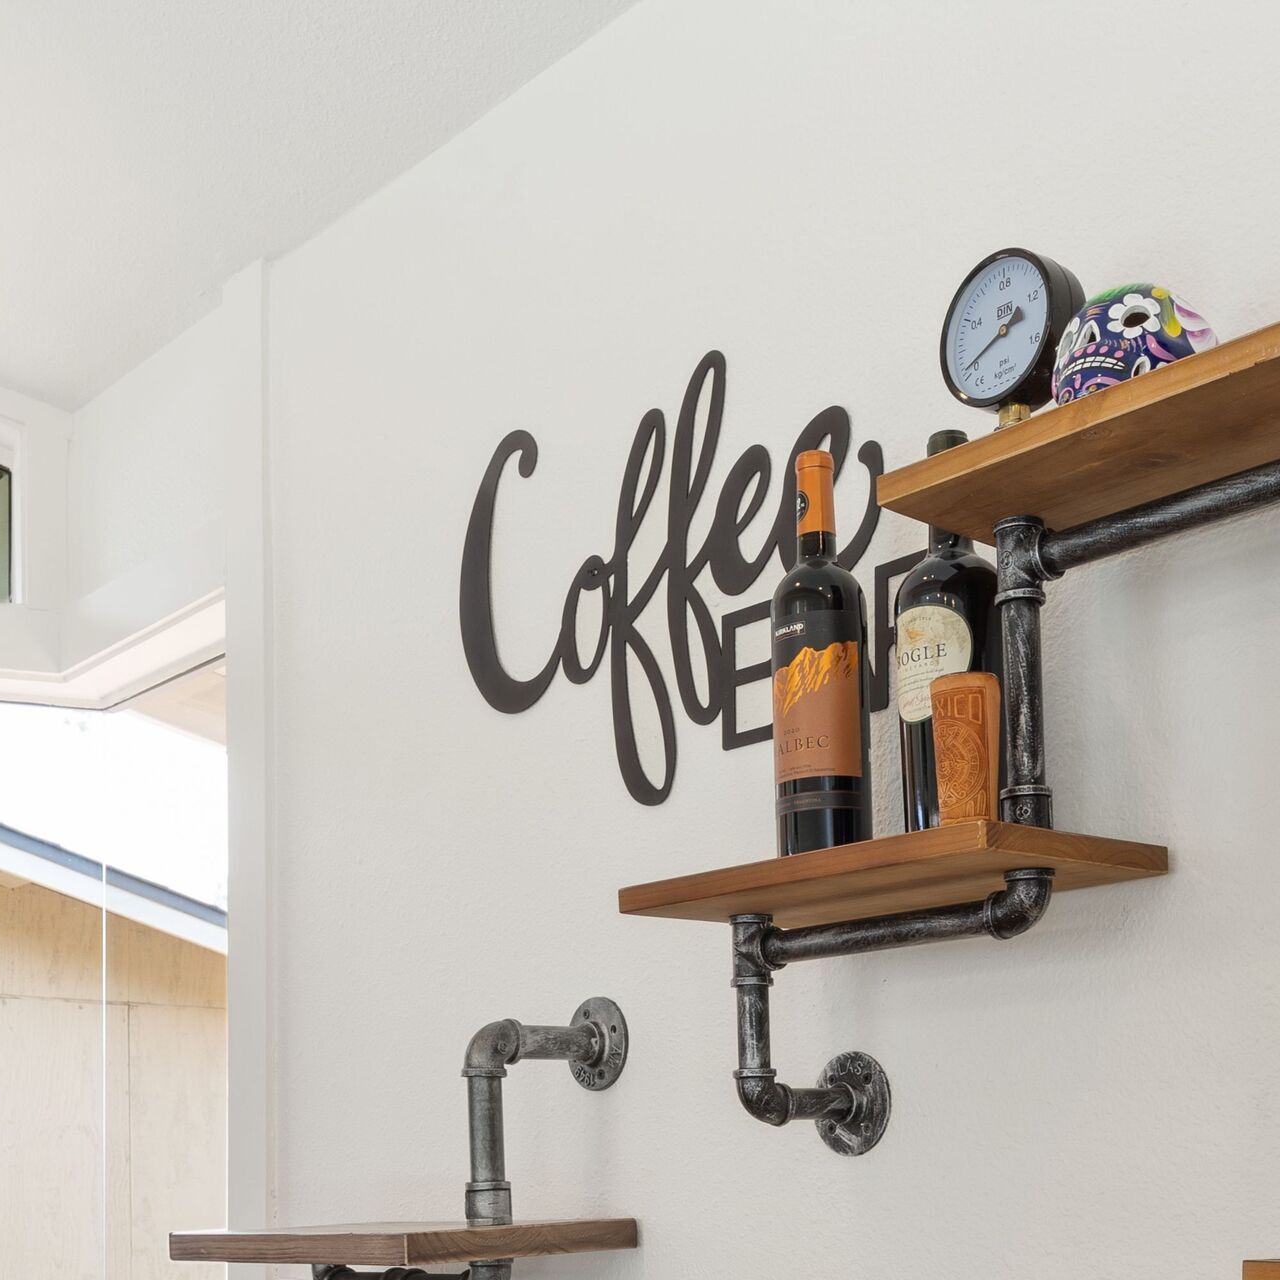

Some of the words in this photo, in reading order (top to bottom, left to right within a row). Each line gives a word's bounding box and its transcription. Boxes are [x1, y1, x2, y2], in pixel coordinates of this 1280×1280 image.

[999, 277, 1011, 291] 0.8
[1027, 290, 1039, 302] 1.2
[996, 302, 1013, 319] DIN
[971, 317, 982, 330] 0.4
[1029, 332, 1040, 345] 1.6
[973, 361, 980, 371] 0
[459, 349, 884, 806] Coffee
[935, 693, 982, 724] XICO
[778, 735, 830, 755] ALBEC
